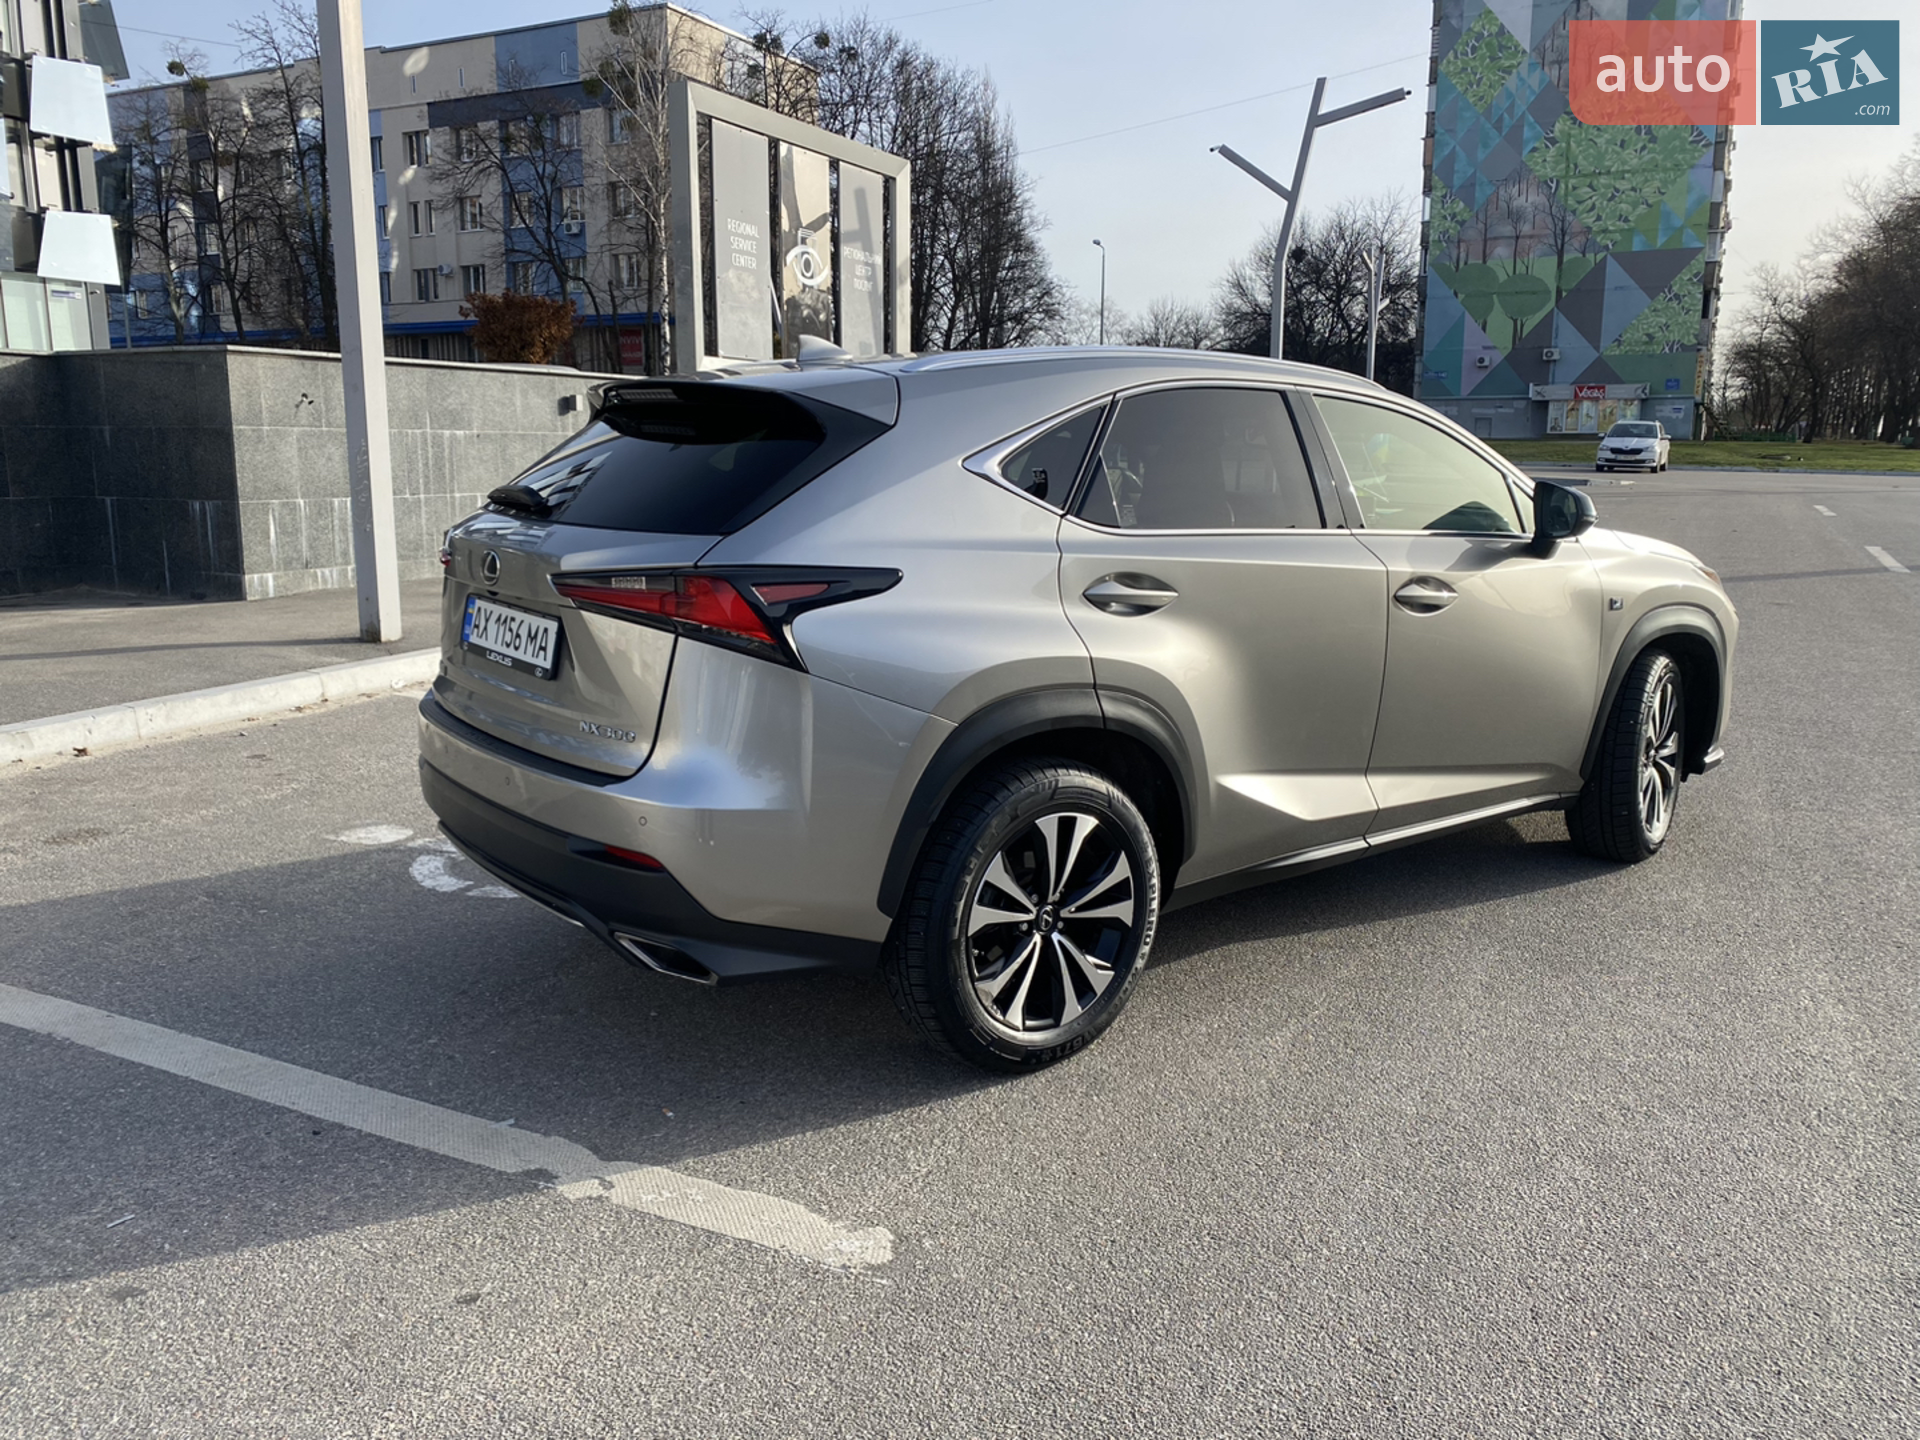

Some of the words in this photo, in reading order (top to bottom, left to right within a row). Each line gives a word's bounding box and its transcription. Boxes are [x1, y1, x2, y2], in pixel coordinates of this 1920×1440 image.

[727, 218, 760, 238] REGIONAL
[730, 235, 757, 254] SERVICE
[731, 252, 757, 270] CENTER
[471, 606, 493, 642] AX
[494, 612, 525, 652] 1156
[523, 622, 549, 662] MA
[486, 650, 513, 667] LEXUS
